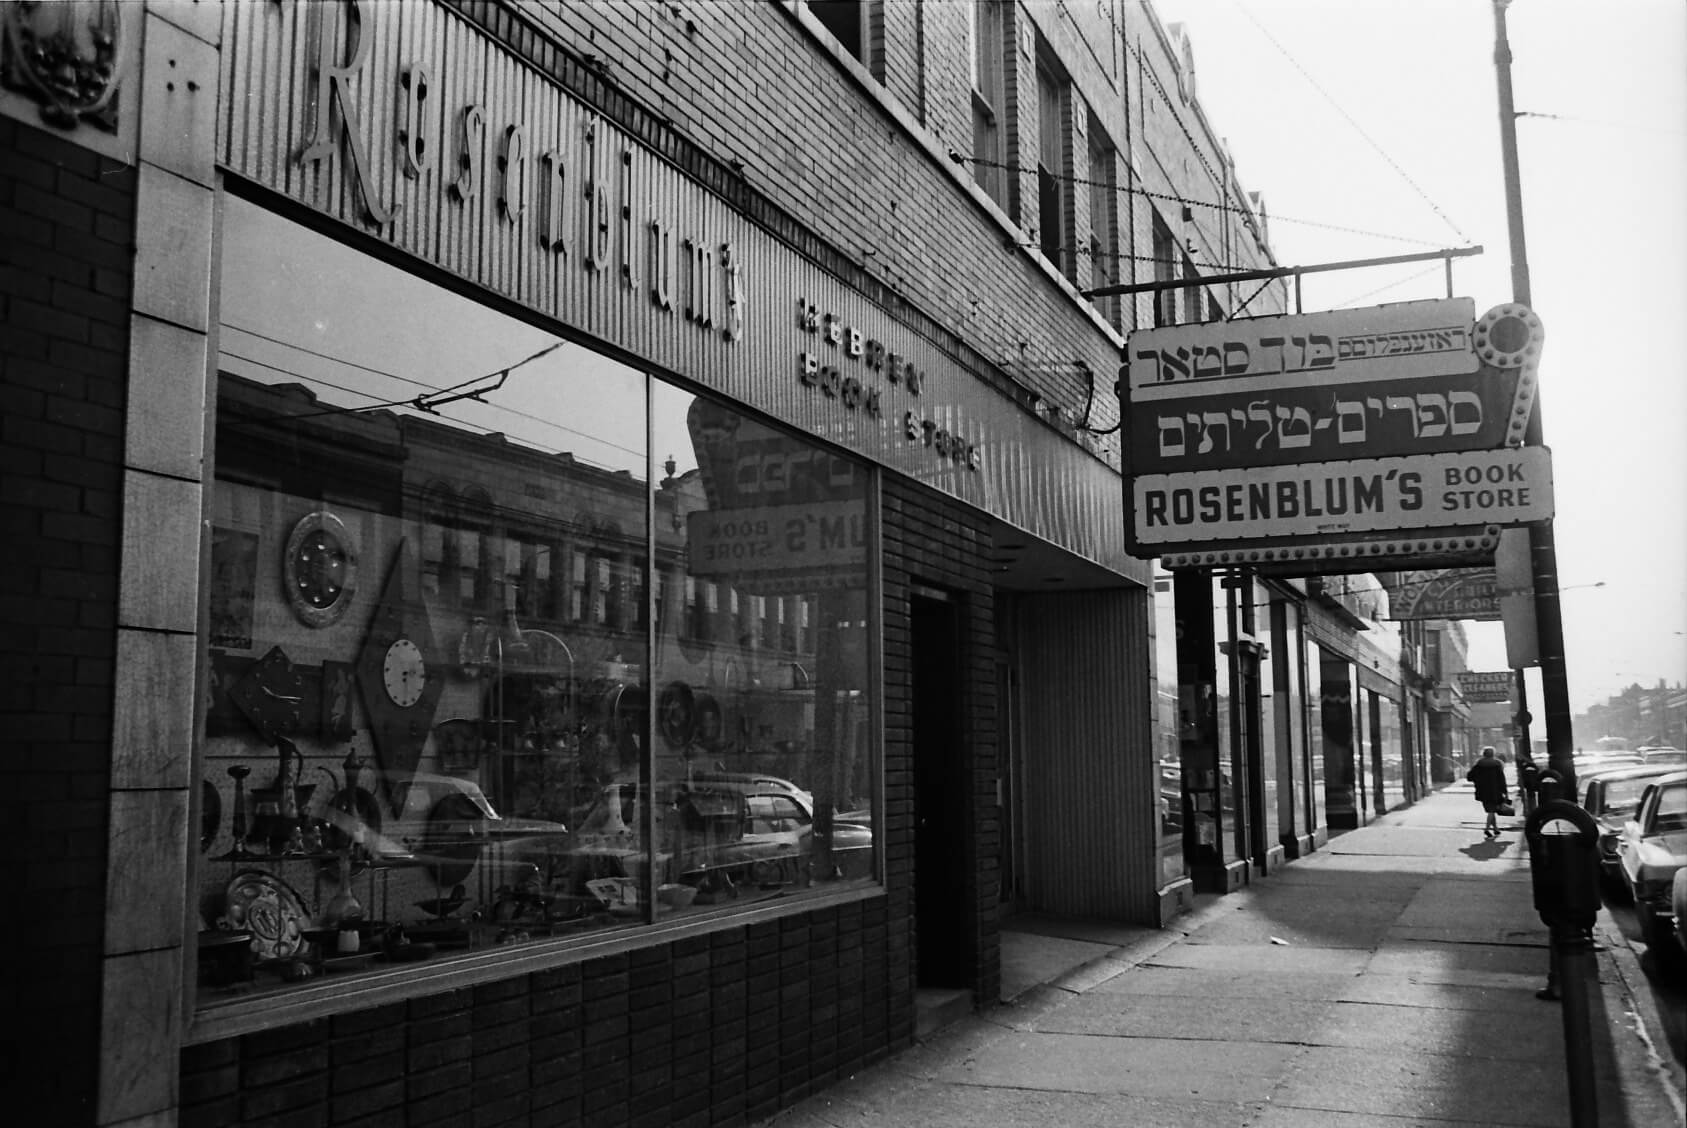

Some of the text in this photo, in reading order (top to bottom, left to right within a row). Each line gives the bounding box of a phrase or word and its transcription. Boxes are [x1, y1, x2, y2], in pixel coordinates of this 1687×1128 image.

[799, 298, 925, 397] HEBREW
[799, 352, 981, 472] BOOK STORE
[1145, 468, 1423, 527] ROSENBLUM'S
[1441, 487, 1531, 512] STORE
[1444, 463, 1525, 487] BOOK
